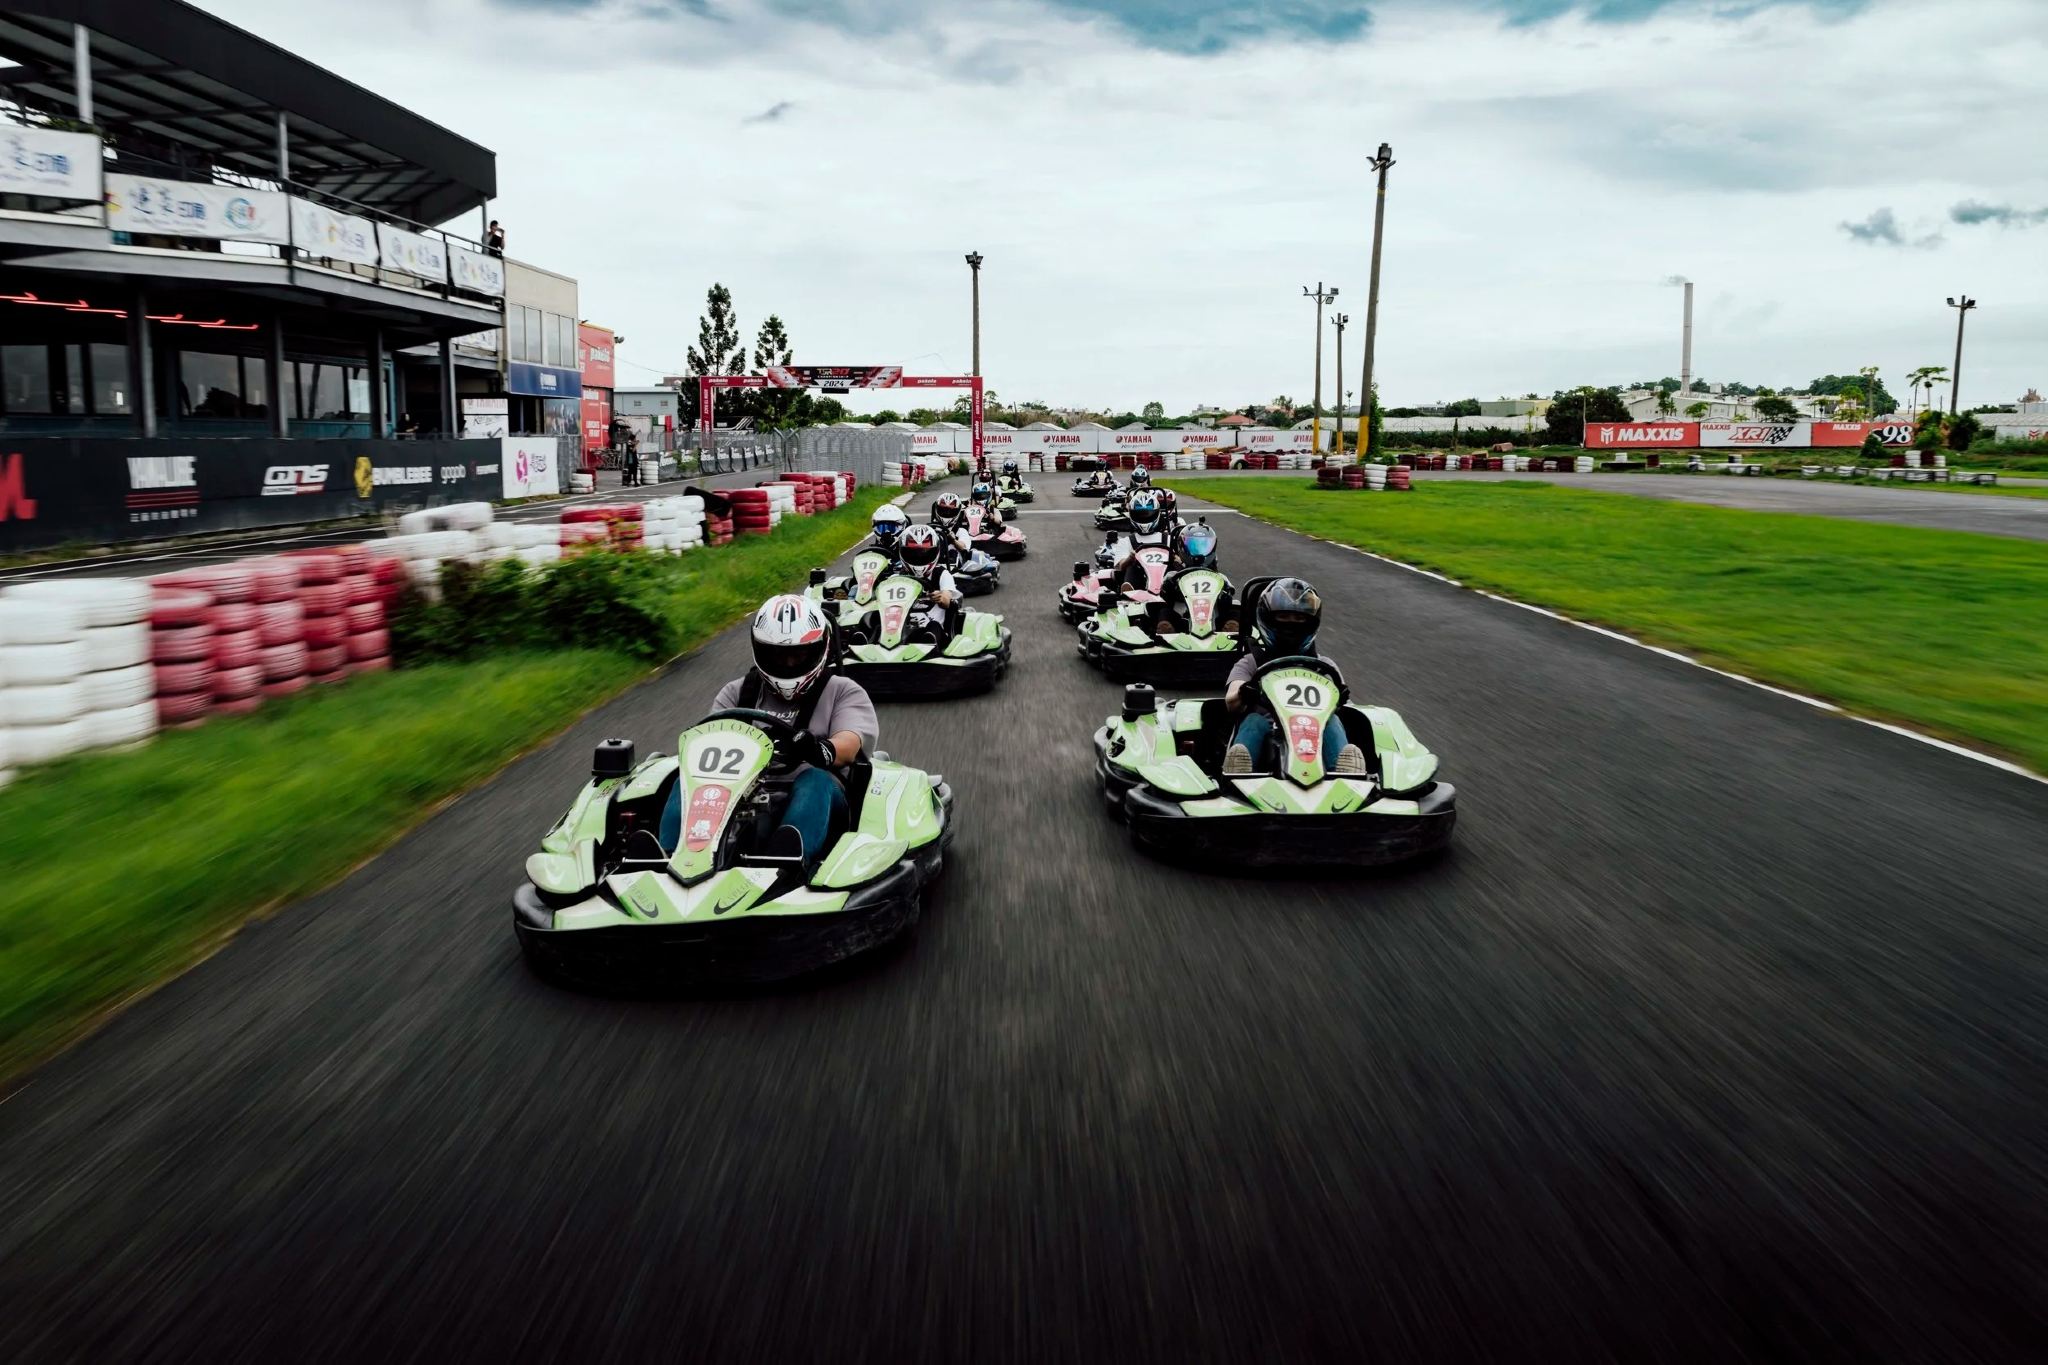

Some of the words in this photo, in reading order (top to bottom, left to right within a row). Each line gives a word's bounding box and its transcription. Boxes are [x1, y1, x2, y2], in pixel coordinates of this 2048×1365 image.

[982, 435, 1012, 443] YAMAHA
[1052, 435, 1080, 443] YAMAHA
[1123, 435, 1152, 443] YAMAHA
[1190, 435, 1218, 443] YAMAHA
[1617, 428, 1684, 441] MAXXIS
[911, 436, 938, 444] AMAHA
[970, 508, 981, 516] 24
[1145, 554, 1163, 563] 22
[862, 561, 877, 570] 10
[1192, 582, 1211, 593] 12
[886, 587, 906, 600] 16
[1285, 684, 1321, 707] 20
[698, 746, 745, 775] 02
